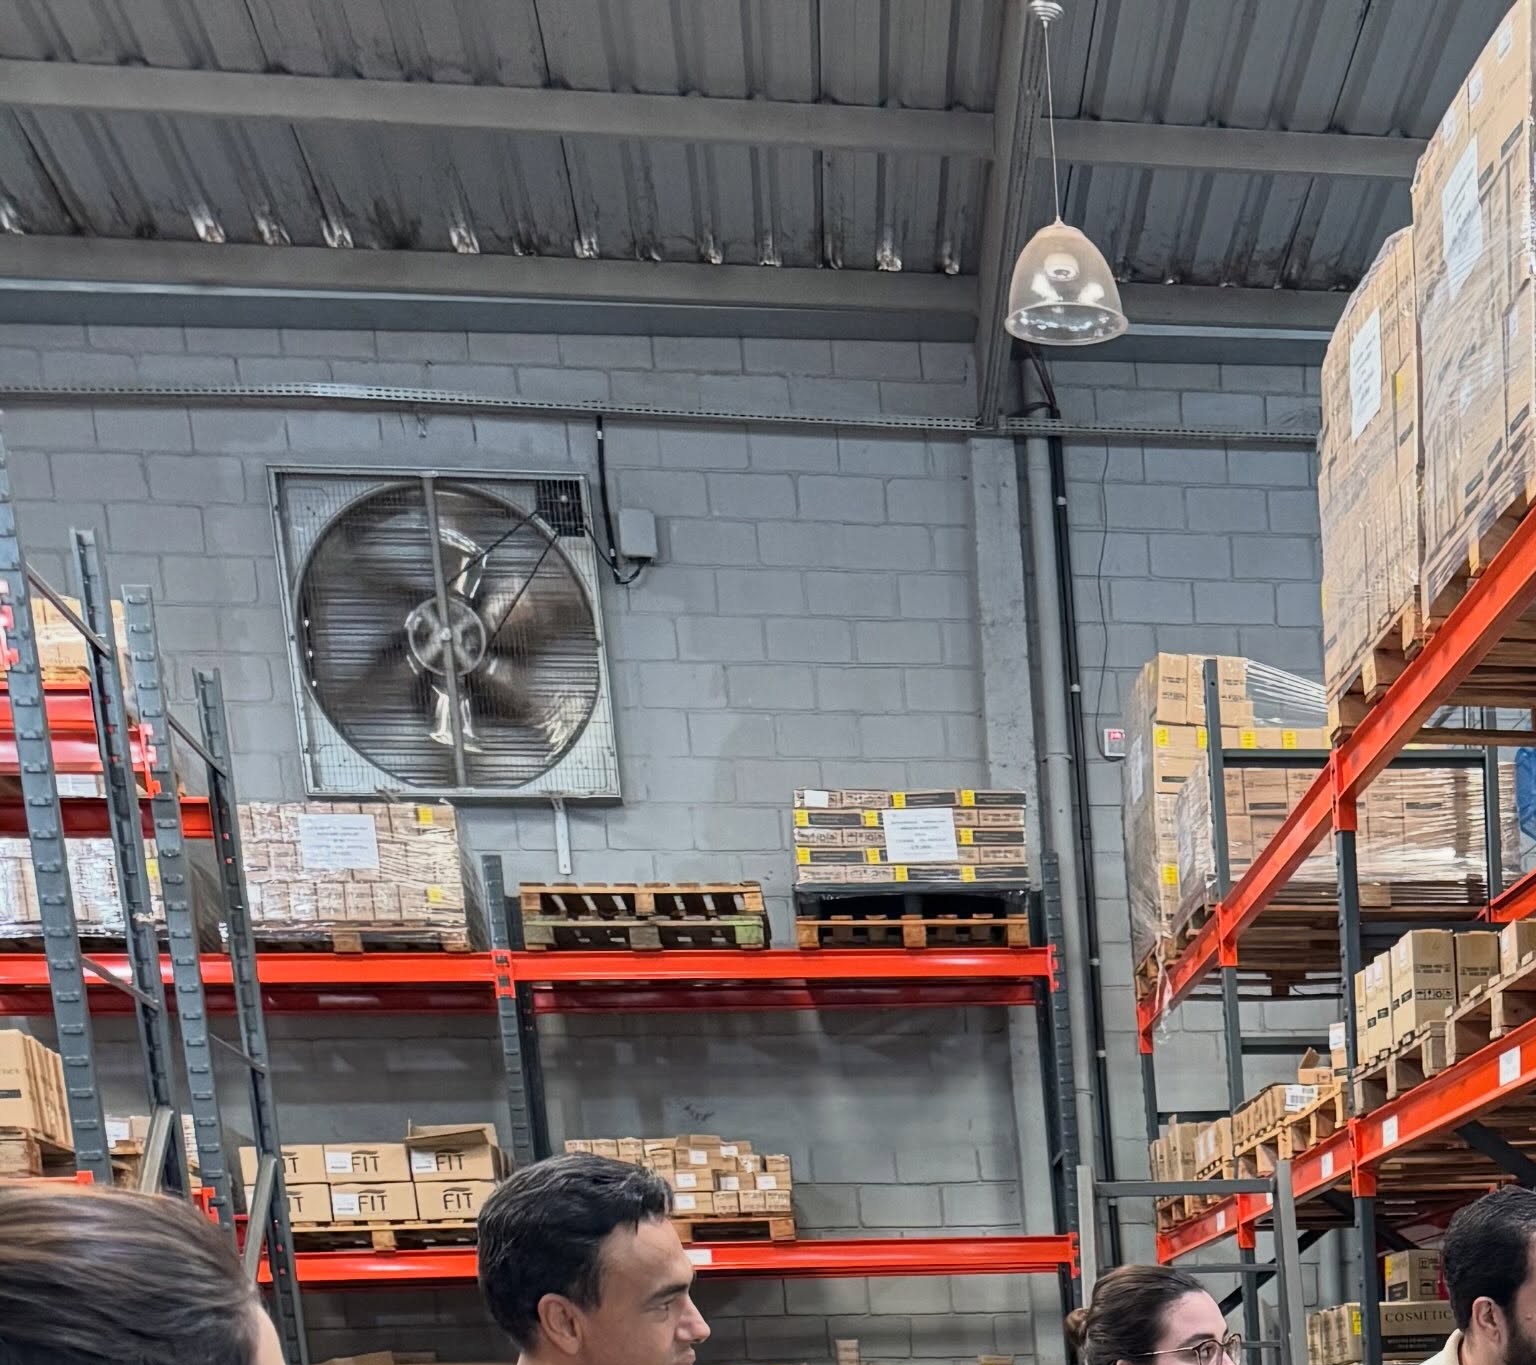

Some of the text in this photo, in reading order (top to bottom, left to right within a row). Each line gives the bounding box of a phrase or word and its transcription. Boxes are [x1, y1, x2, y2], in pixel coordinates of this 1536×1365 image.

[352, 1153, 380, 1172] FIT
[436, 1152, 464, 1171] FIT
[358, 1191, 387, 1211] FIT
[444, 1189, 473, 1210] FIT
